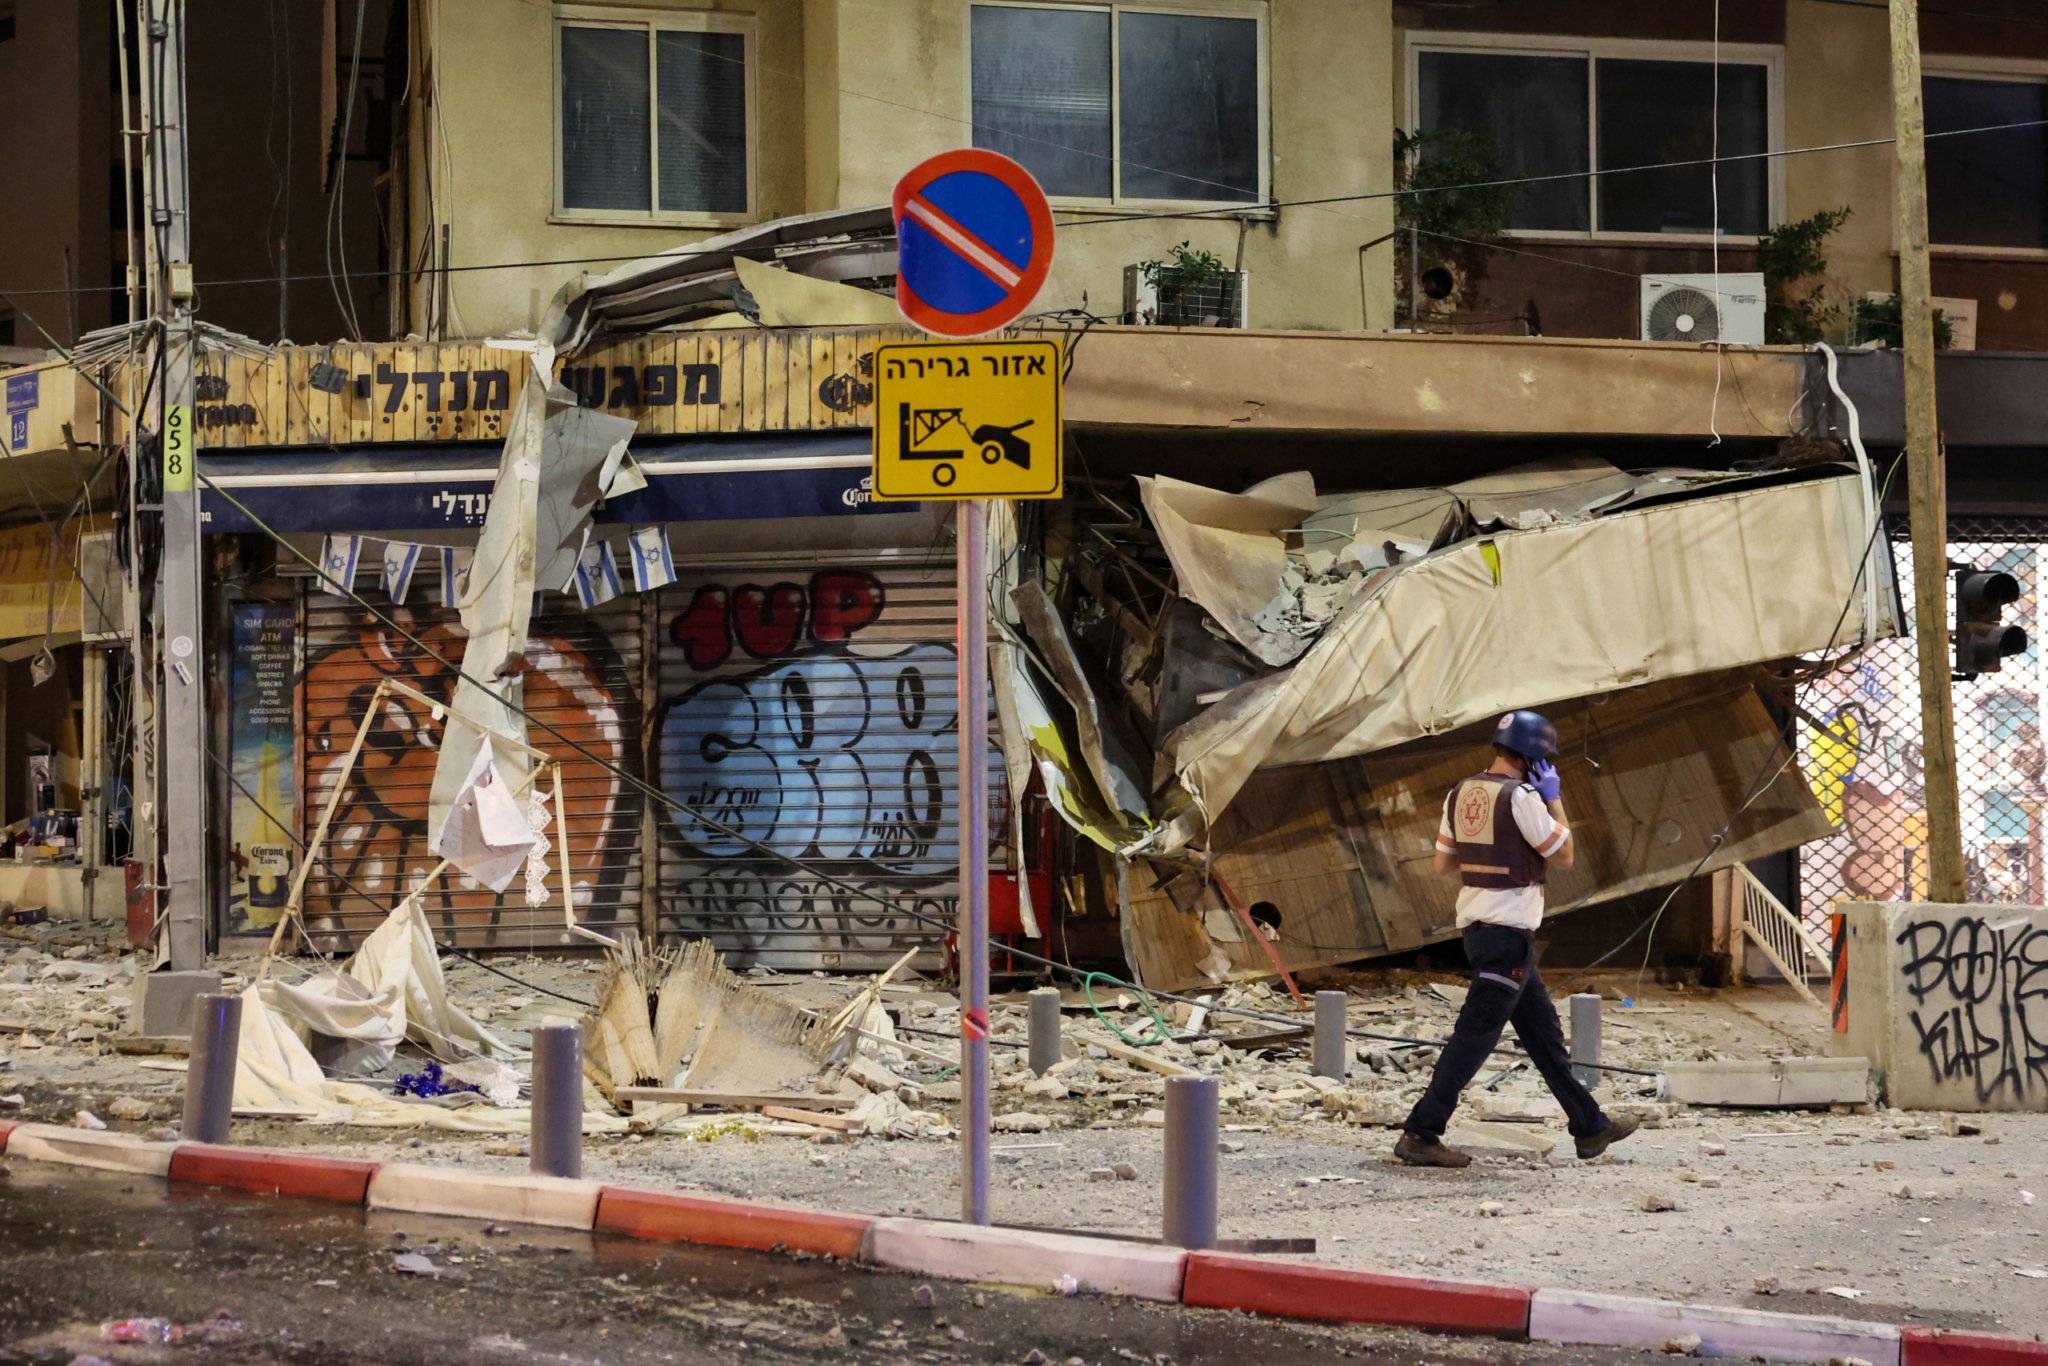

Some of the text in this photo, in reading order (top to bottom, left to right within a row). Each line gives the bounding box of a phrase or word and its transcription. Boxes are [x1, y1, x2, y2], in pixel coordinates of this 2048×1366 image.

[887, 355, 1046, 379] אזור גרירה
[561, 364, 719, 409] מפגש
[13, 421, 25, 441] 12
[168, 406, 182, 475] 658
[244, 619, 262, 628] SIM
[260, 633, 281, 642] ATM
[251, 846, 284, 858] Corona
[260, 856, 278, 864] Extra
